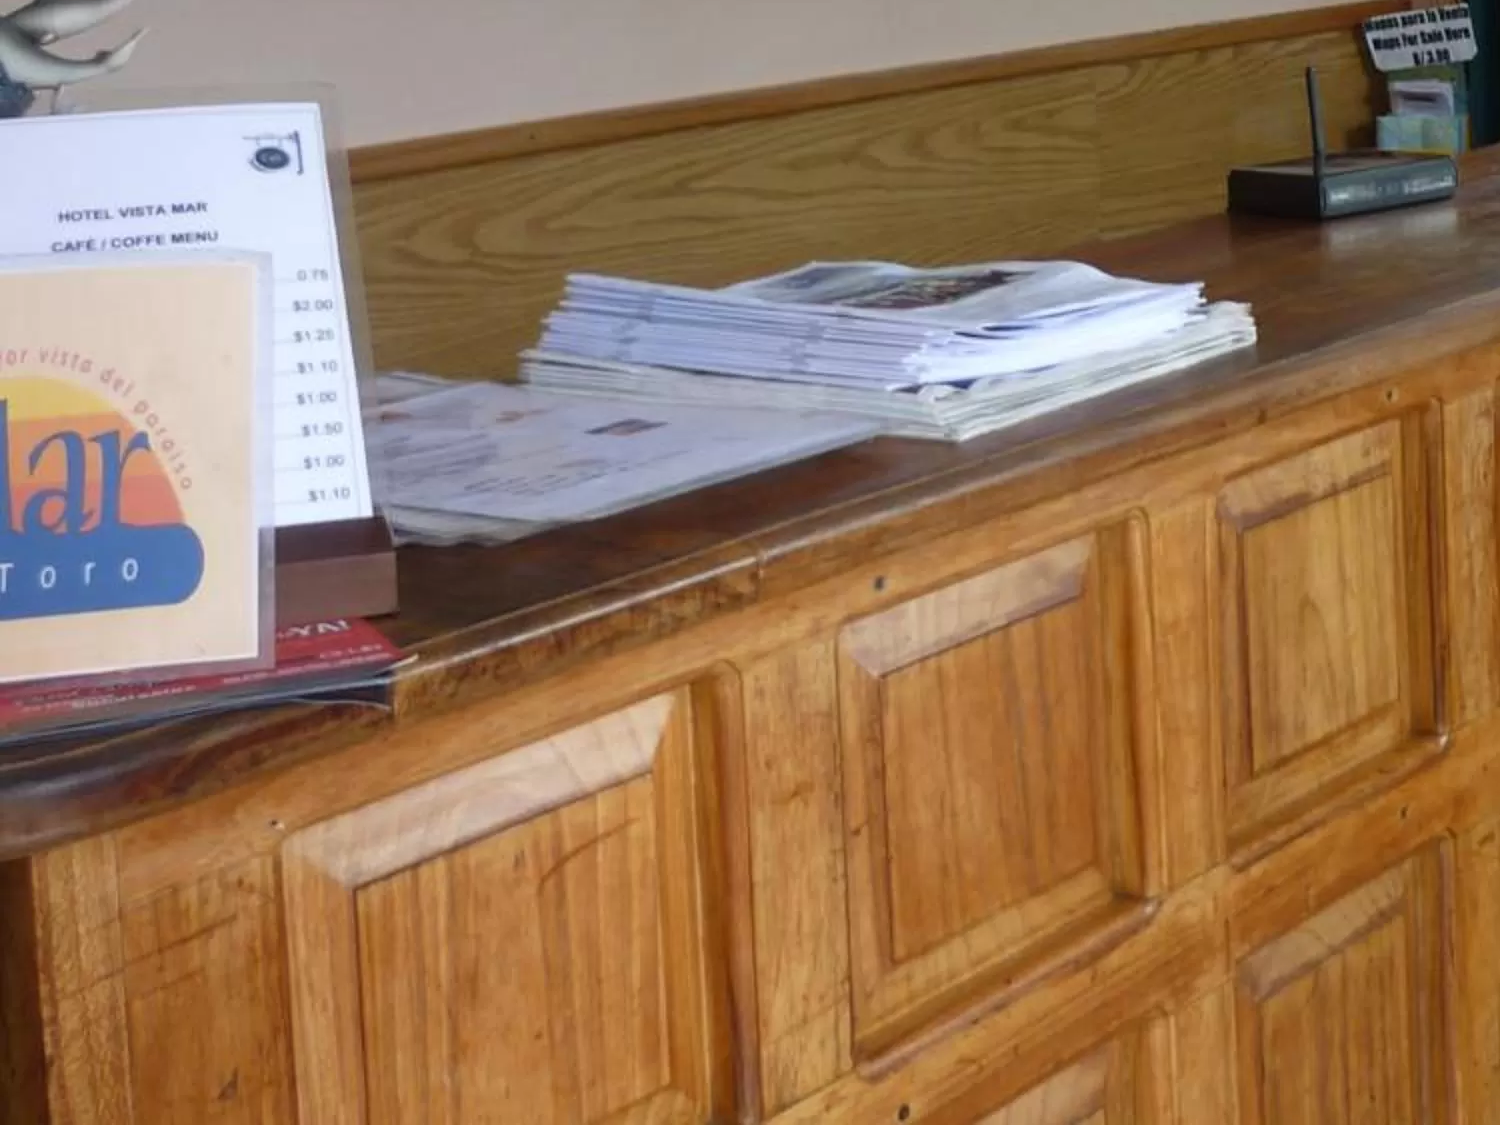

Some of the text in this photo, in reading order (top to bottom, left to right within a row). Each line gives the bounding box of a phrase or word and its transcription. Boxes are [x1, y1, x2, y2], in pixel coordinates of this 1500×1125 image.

[57, 201, 208, 223] HOTEL VISTA MAR
[111, 234, 166, 249] COFFE
[171, 230, 219, 244] MENU
[39, 347, 94, 373] vista
[100, 367, 136, 398] del
